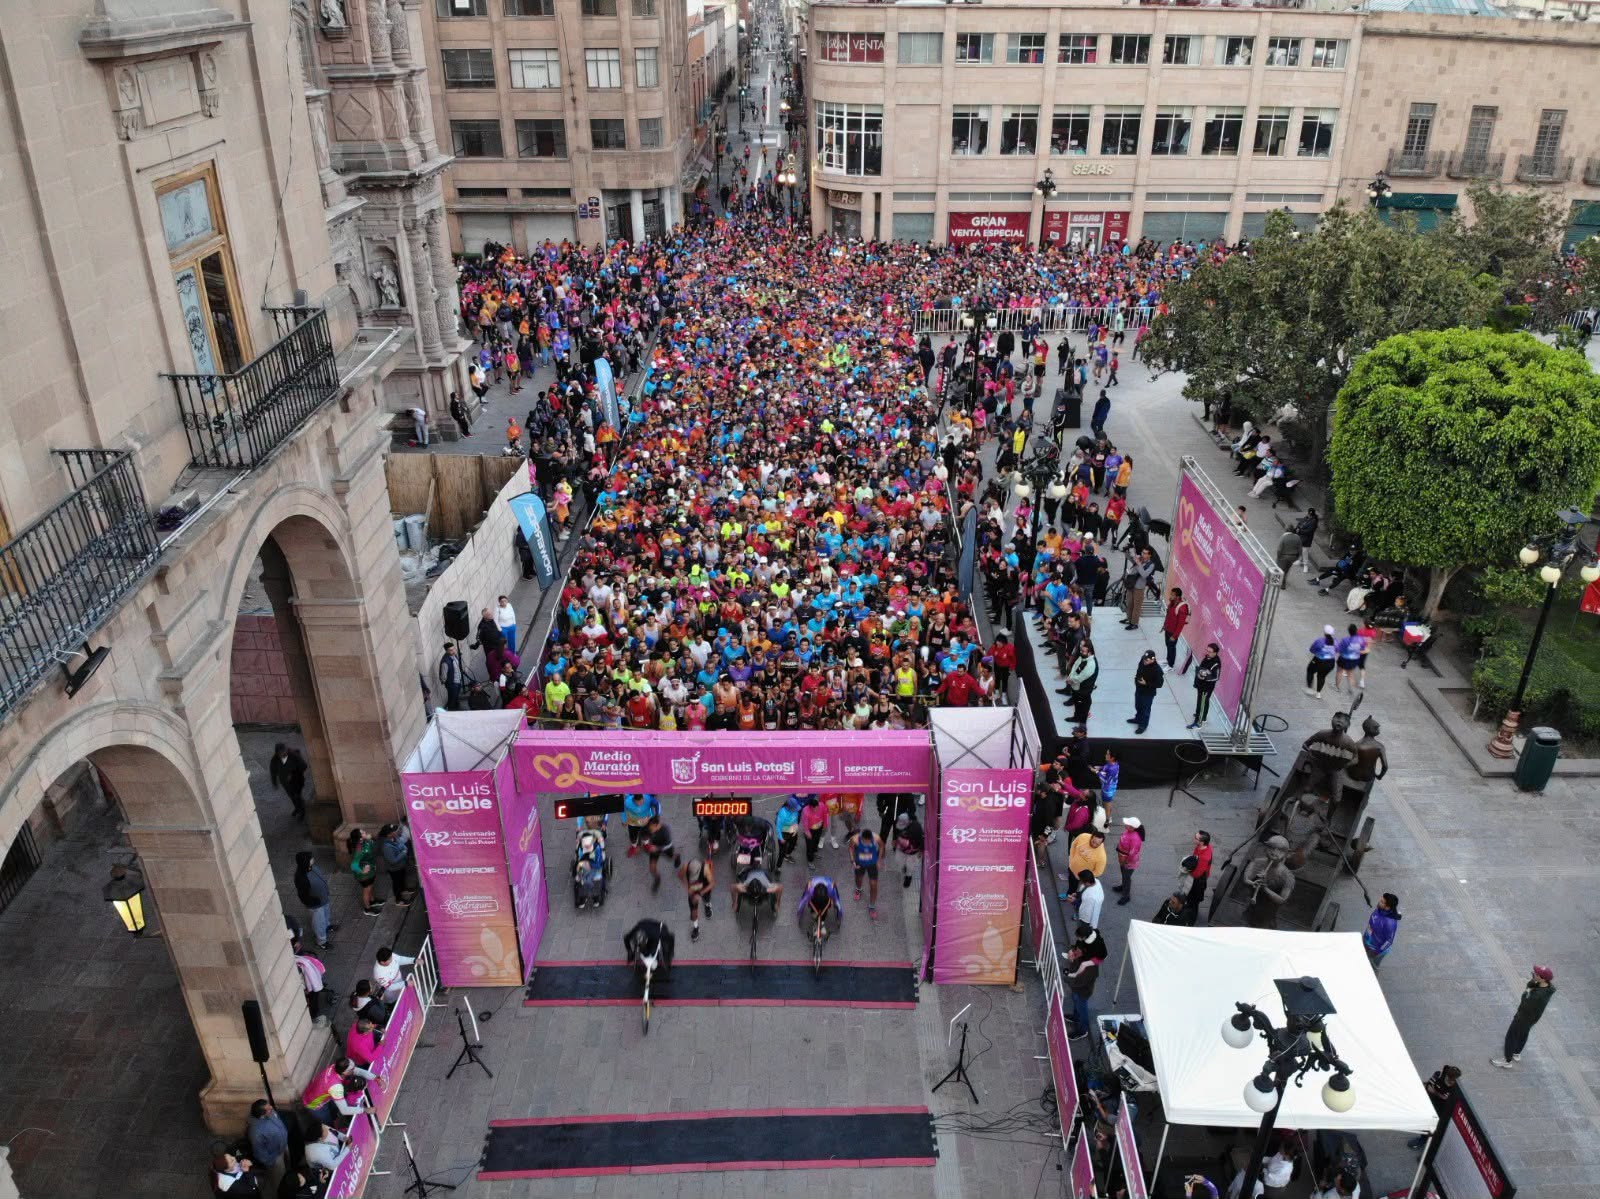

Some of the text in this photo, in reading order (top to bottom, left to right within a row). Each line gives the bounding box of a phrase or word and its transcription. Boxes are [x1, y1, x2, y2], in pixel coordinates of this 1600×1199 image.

[853, 39, 885, 50] VENTA
[1072, 164, 1114, 176] SEARS
[971, 216, 1007, 227] GRAN
[1072, 214, 1101, 222] SEARS
[951, 229, 1024, 237] VENTA ESPECIAL
[590, 750, 632, 761] Medio
[583, 761, 640, 772] Maratón
[701, 762, 725, 773] San
[727, 762, 752, 773] Luis
[408, 782, 490, 797] San Luis
[947, 779, 1027, 793] San Luis
[696, 803, 748, 815] 00:00:00
